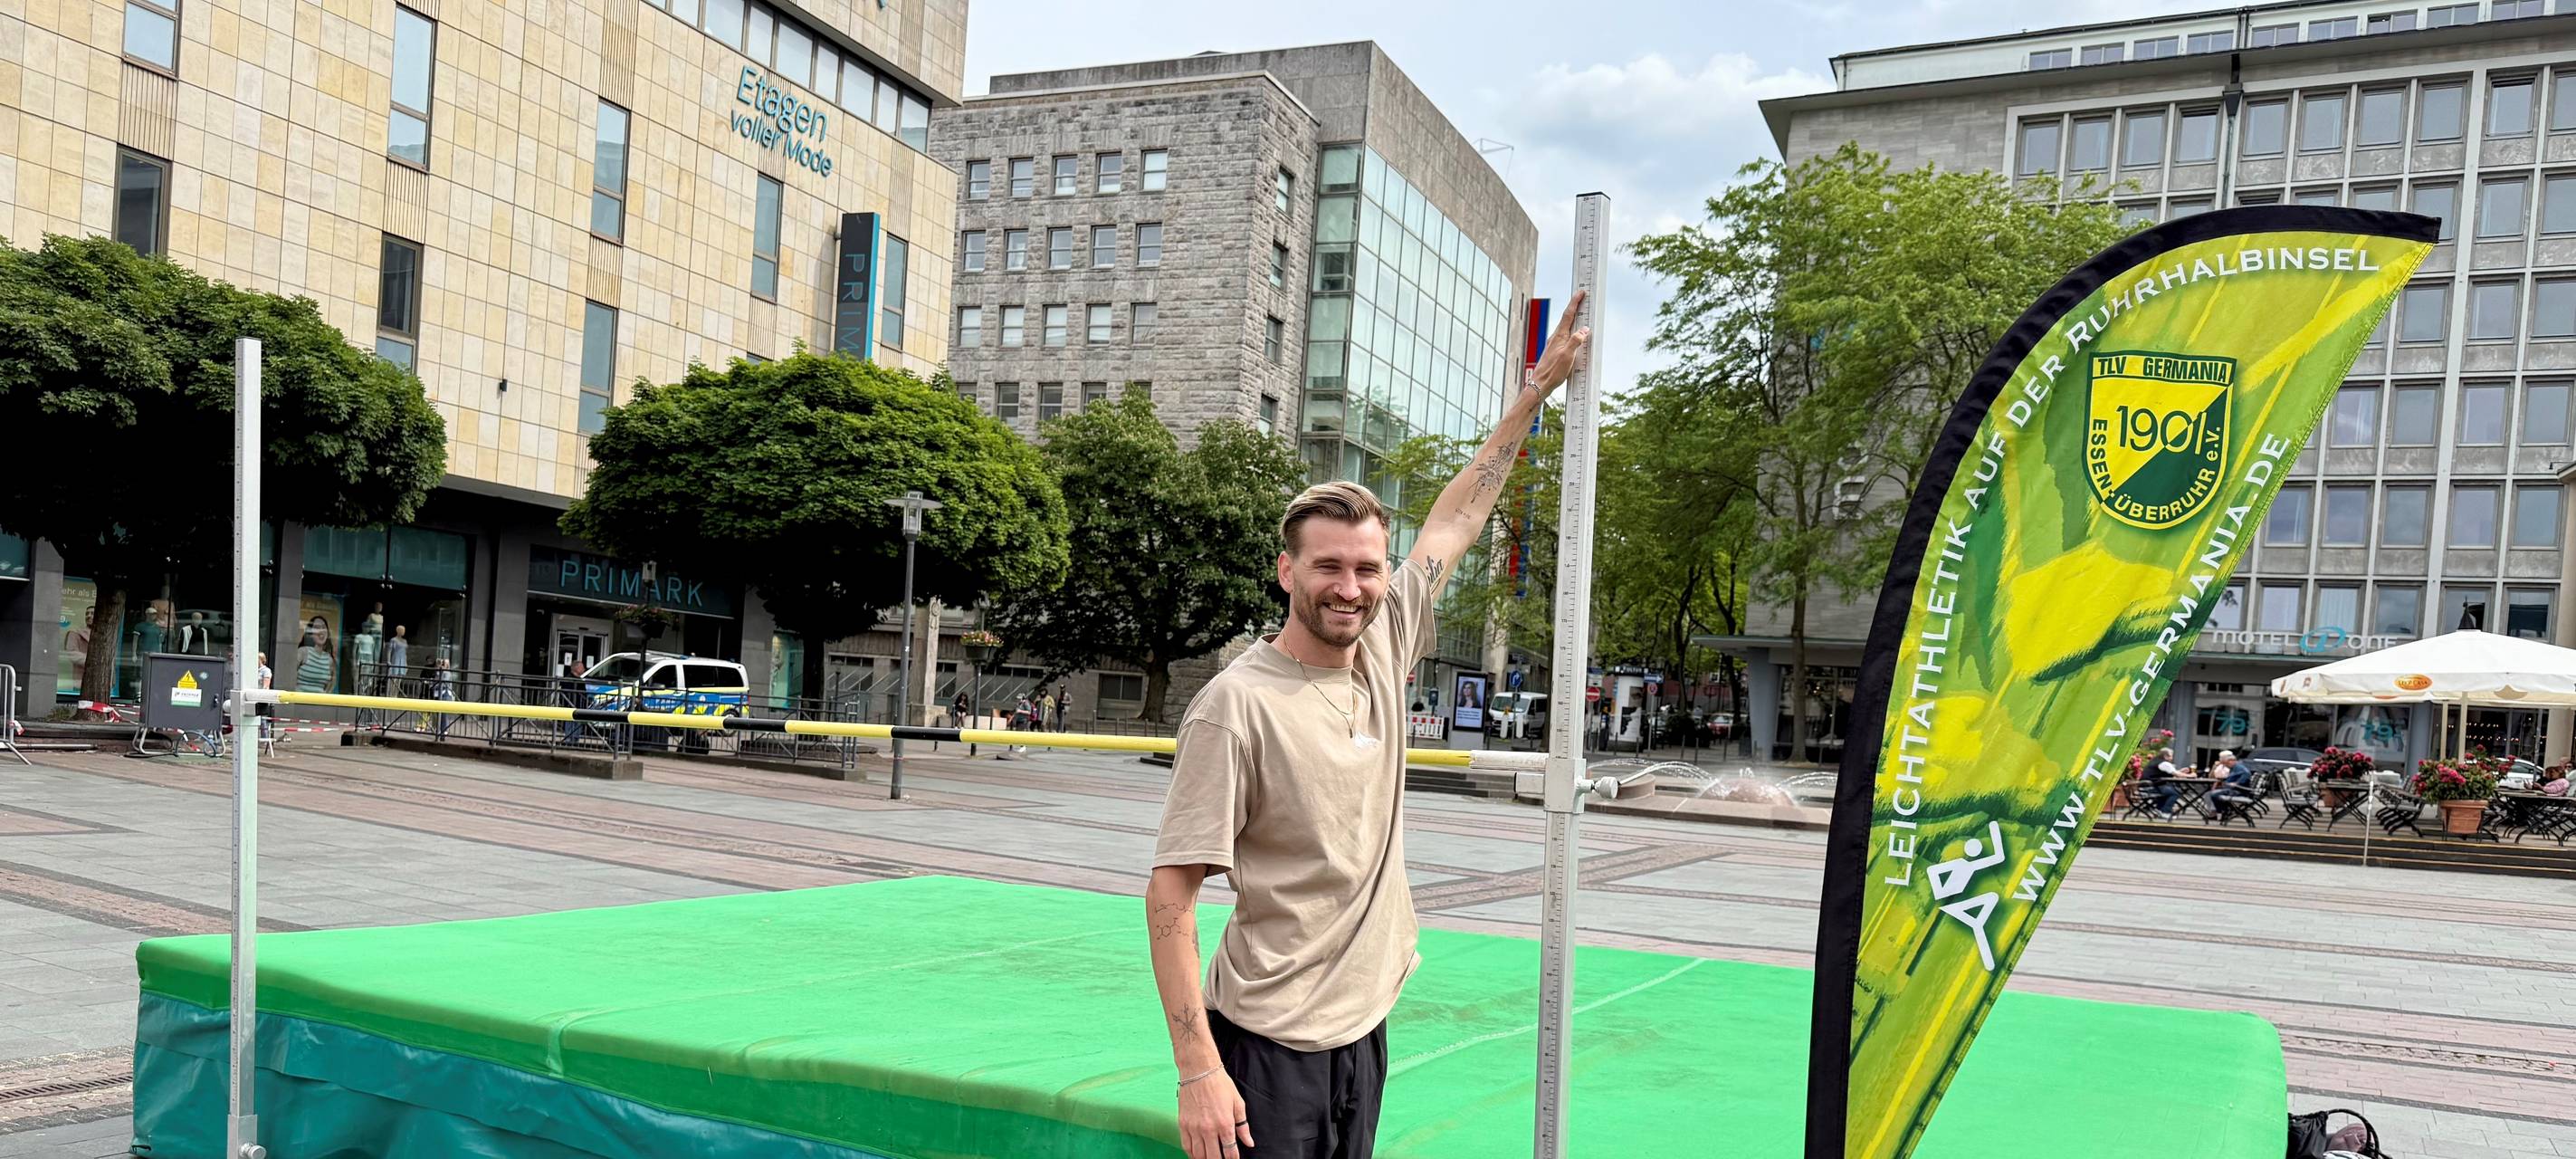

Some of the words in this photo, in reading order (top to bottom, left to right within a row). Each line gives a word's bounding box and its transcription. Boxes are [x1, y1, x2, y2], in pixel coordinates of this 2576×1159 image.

[737, 65, 827, 143] Etagen
[731, 110, 782, 151] voller
[783, 133, 832, 177] Mode
[2097, 357, 2127, 376] TLV
[2142, 357, 2227, 383] GERMANIA
[2116, 406, 2207, 455] 1901
[1884, 517, 1971, 886] LEICHTATHLETIK
[1963, 432, 2008, 511] AUF
[2006, 354, 2067, 428] DER
[2065, 247, 2380, 354] RUHRHALBINSEL
[2212, 630, 2299, 647] MOTEL
